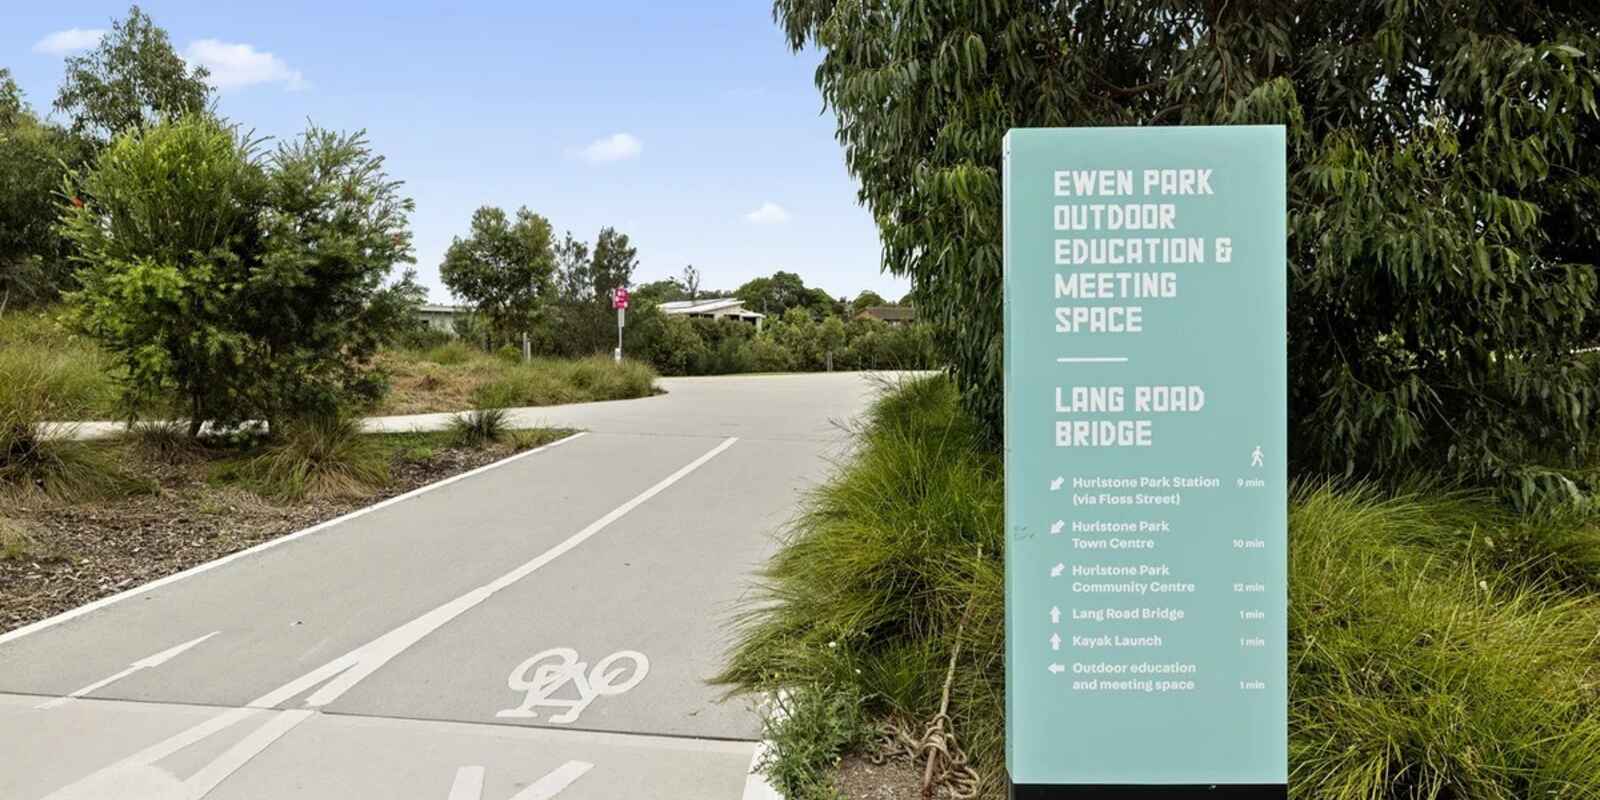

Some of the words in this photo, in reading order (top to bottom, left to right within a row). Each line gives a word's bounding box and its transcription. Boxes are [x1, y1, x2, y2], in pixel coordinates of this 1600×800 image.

[1054, 170, 1133, 196] EWEN
[1144, 169, 1214, 195] PARK
[1054, 203, 1176, 230] OUTDOOR
[1054, 238, 1204, 264] EDUCATION
[1216, 237, 1231, 263] &
[1055, 272, 1177, 299] MEETING
[1055, 307, 1142, 332] SPACE
[1055, 386, 1124, 412] LANG
[1136, 386, 1205, 412] ROAD
[1055, 421, 1152, 447] BRIDGE
[1073, 477, 1137, 488] Hurlstone
[1140, 477, 1170, 488] Park
[1173, 477, 1220, 488] Station
[1245, 478, 1264, 487] min
[1073, 494, 1096, 506] (via
[1099, 494, 1133, 505] Floss
[1135, 494, 1180, 506] Street)
[1073, 521, 1137, 532] Hurlstone
[1140, 521, 1169, 532] Park
[1072, 538, 1107, 549] Town
[1110, 538, 1154, 549] Centre
[1233, 540, 1244, 548] 10
[1245, 539, 1264, 548] min
[1073, 565, 1137, 576] Hurlstone
[1140, 565, 1170, 576] Park
[1072, 581, 1148, 596] Community
[1151, 581, 1195, 593] Centre
[1234, 583, 1244, 592] 12
[1245, 583, 1264, 592] min
[1073, 608, 1104, 621] Lang
[1106, 608, 1140, 619] Road
[1143, 608, 1184, 621] Bridge
[1245, 610, 1264, 619] min
[1073, 635, 1112, 649] Kayak
[1115, 635, 1162, 646] Launch
[1245, 637, 1264, 646] min
[1073, 662, 1128, 673] Outdoor
[1130, 662, 1196, 673] education
[1072, 679, 1097, 690] and
[1099, 679, 1153, 692] meeting
[1155, 680, 1195, 692] space
[1245, 680, 1264, 689] min
